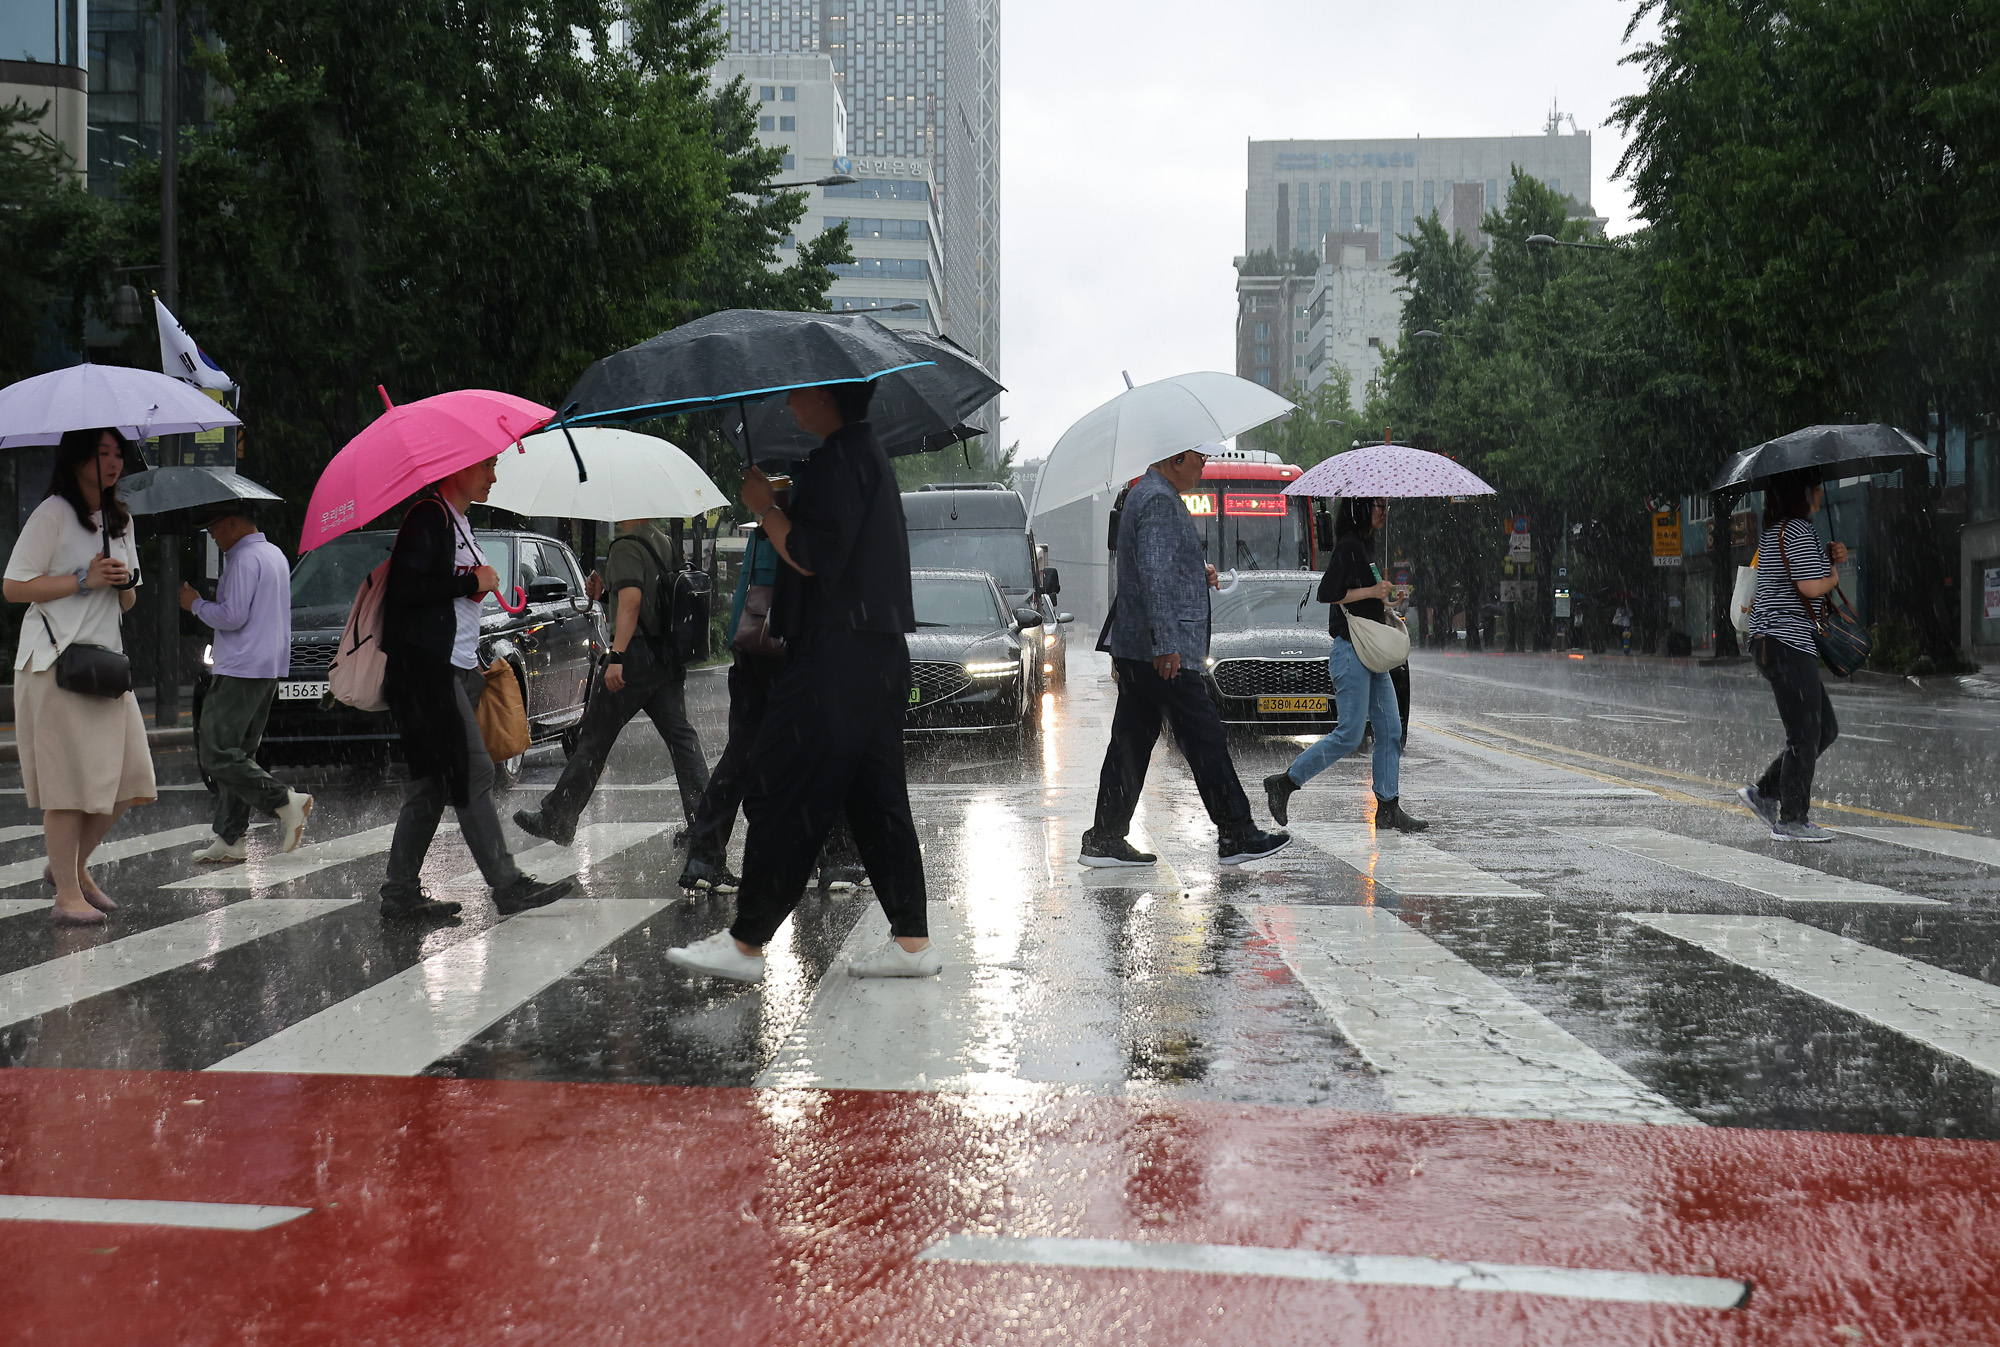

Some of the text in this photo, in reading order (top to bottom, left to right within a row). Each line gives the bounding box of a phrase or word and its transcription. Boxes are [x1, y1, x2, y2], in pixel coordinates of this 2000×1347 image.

[857, 159, 923, 176] 신한은행
[321, 499, 355, 525] 우리약국
[1293, 699, 1322, 710] 4426
